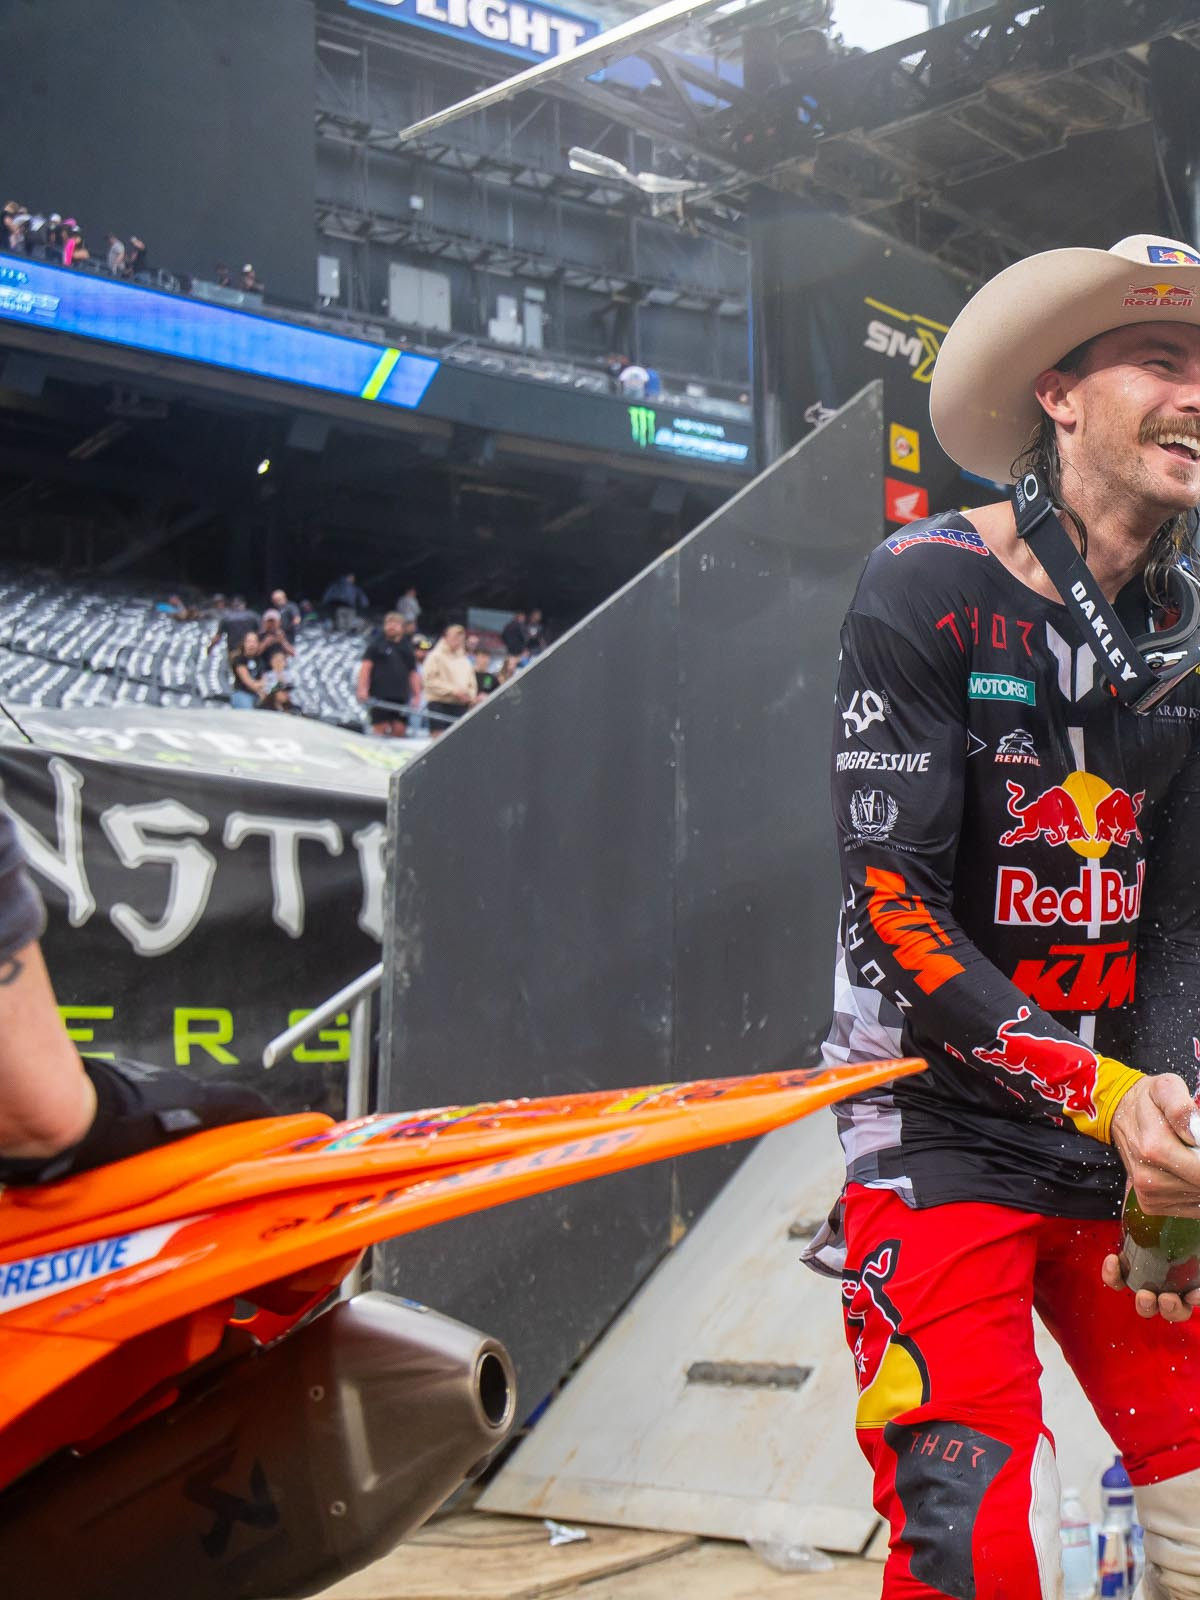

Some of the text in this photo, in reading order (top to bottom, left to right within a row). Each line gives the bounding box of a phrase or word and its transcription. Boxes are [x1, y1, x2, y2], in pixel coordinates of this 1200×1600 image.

[1124, 298, 1193, 306] Red Bull
[1071, 580, 1139, 682] OAKLEY
[836, 752, 932, 773] PROGRESSIVE
[998, 868, 1092, 924] Red
[864, 866, 966, 995] KTM
[1011, 942, 1137, 1011] KTM
[0, 1233, 138, 1297] RESSIVE
